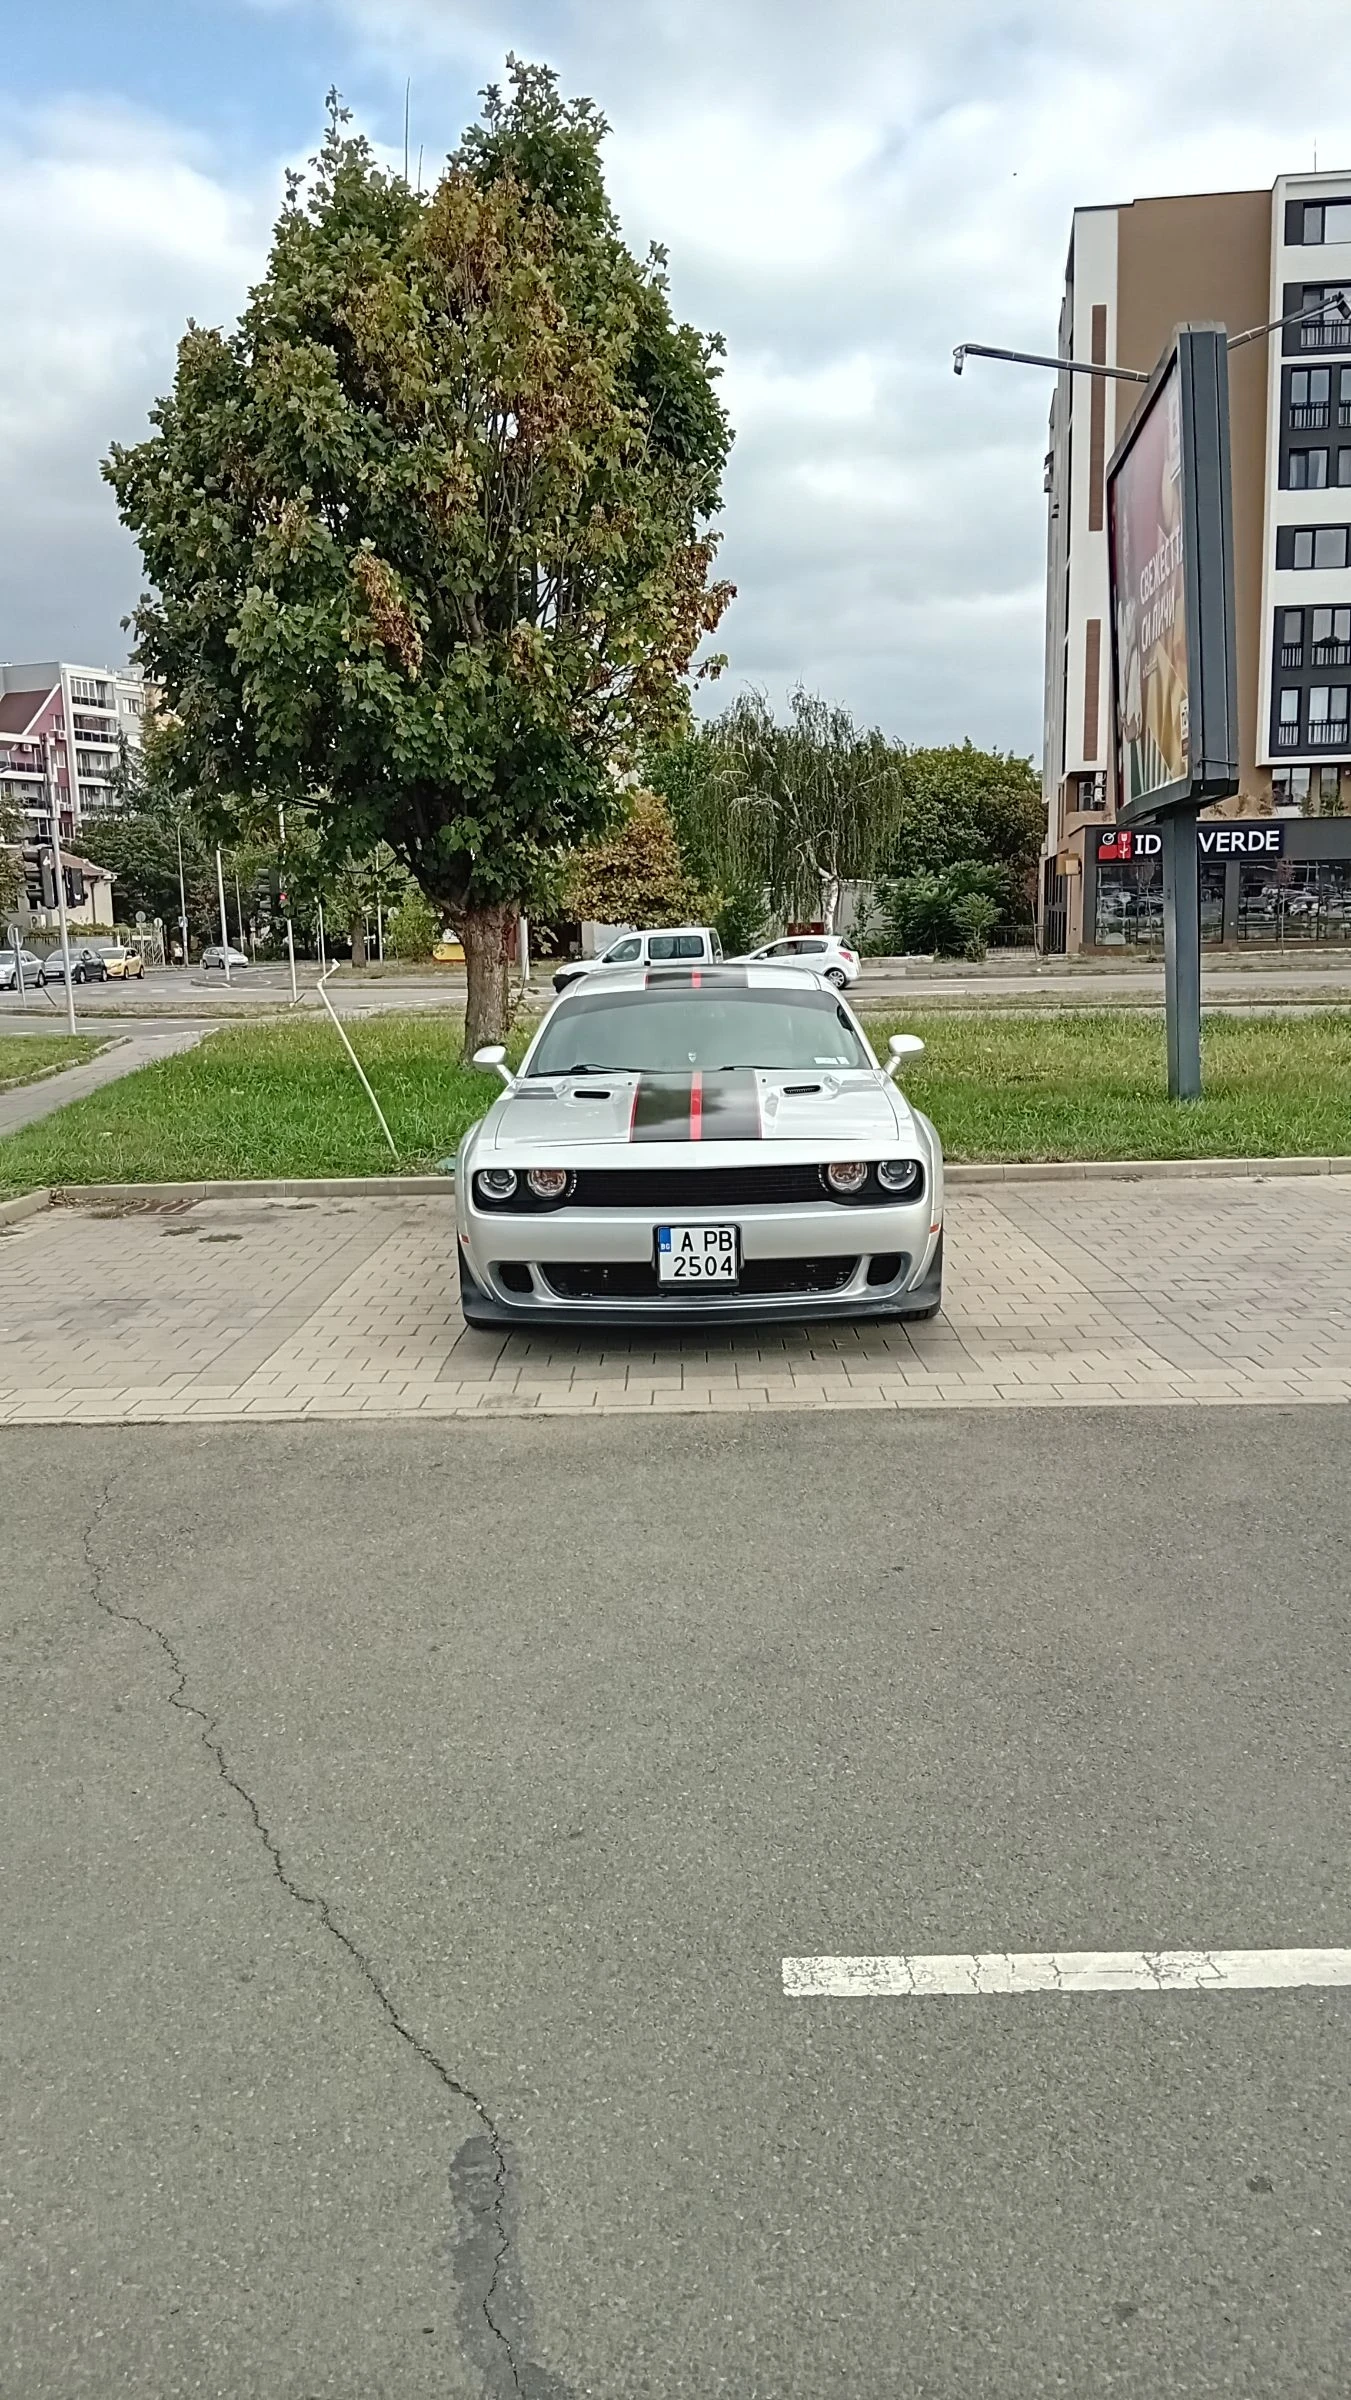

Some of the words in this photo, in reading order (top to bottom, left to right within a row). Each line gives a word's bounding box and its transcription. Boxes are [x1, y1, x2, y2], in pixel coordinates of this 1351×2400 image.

[1134, 834, 1162, 855] ID
[1198, 830, 1280, 853] VERDE
[681, 1231, 693, 1252] A
[704, 1231, 733, 1252] PB
[674, 1256, 733, 1277] 2504
